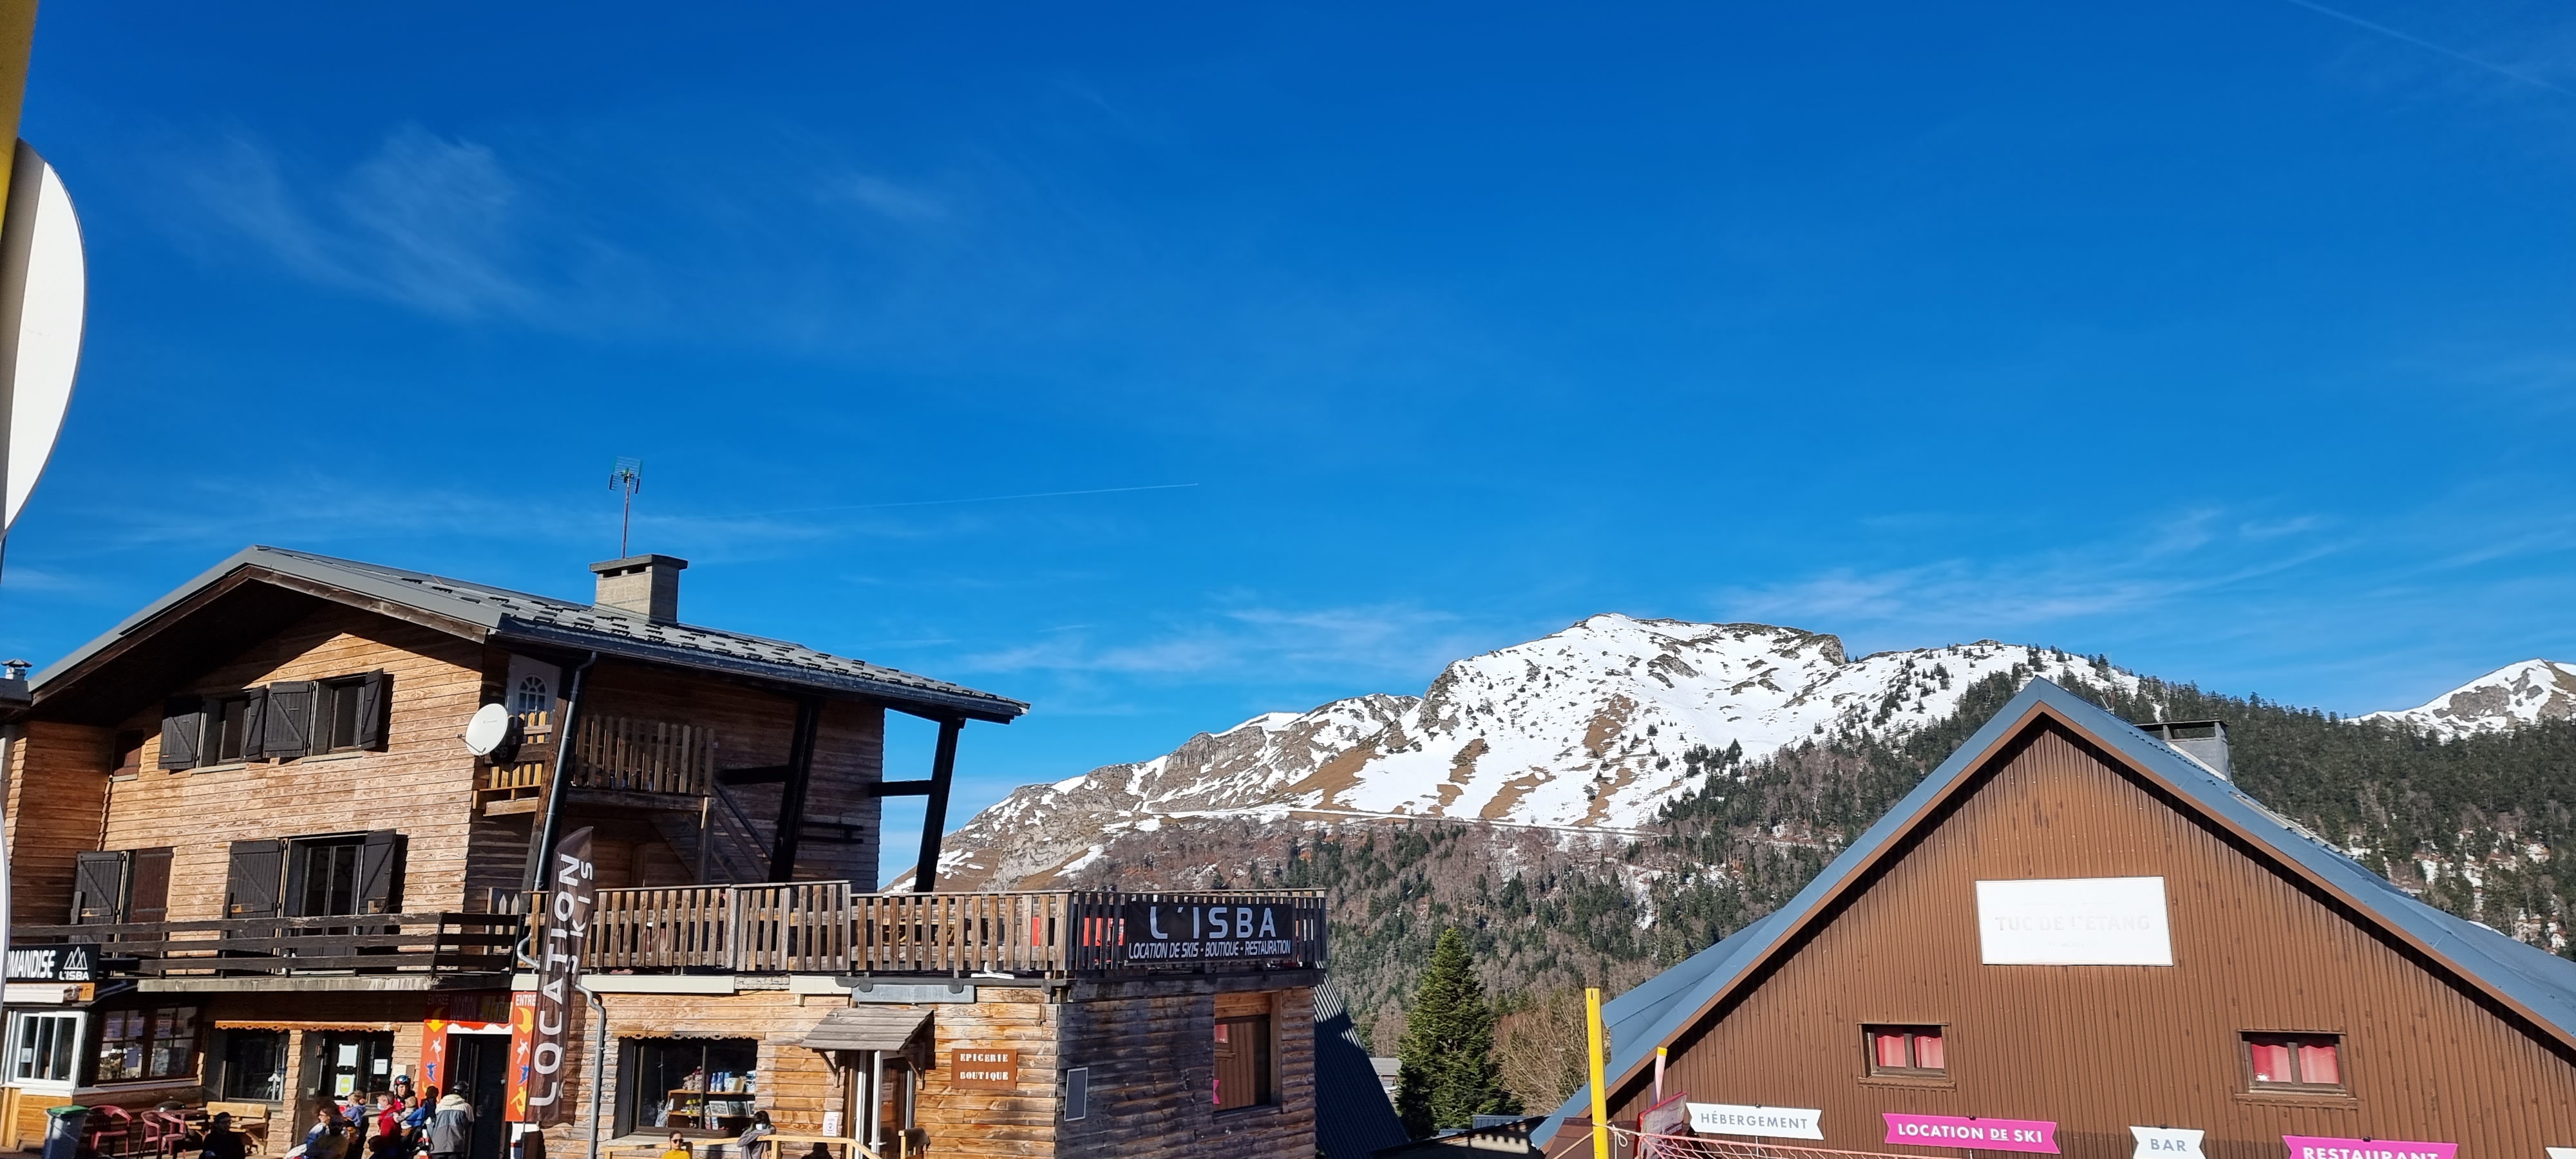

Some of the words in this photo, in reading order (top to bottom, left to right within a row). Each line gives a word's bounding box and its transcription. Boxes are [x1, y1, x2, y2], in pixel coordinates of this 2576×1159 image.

[1150, 906, 1276, 939] L'ISBA
[1995, 916, 2033, 932] TUC
[2040, 916, 2064, 932] DE
[1129, 942, 1167, 959] LOCATION
[1169, 942, 1180, 958] DE
[1181, 942, 1199, 957] SKIS
[1205, 941, 1239, 957] BOUTIQUE
[1244, 939, 1291, 956] RESTAURATION
[59, 970, 90, 981] L'ISBA
[529, 853, 580, 1106] LOCATION
[960, 1053, 1009, 1062] EPICERIE
[960, 1071, 1009, 1082] BOUTIQUE
[1701, 1110, 1808, 1129] HÉBERGEMENT
[1898, 1123, 1984, 1140] LOCATION
[1990, 1128, 2009, 1141] DE
[2014, 1129, 2042, 1143] SKI
[2150, 1138, 2187, 1152] BAR
